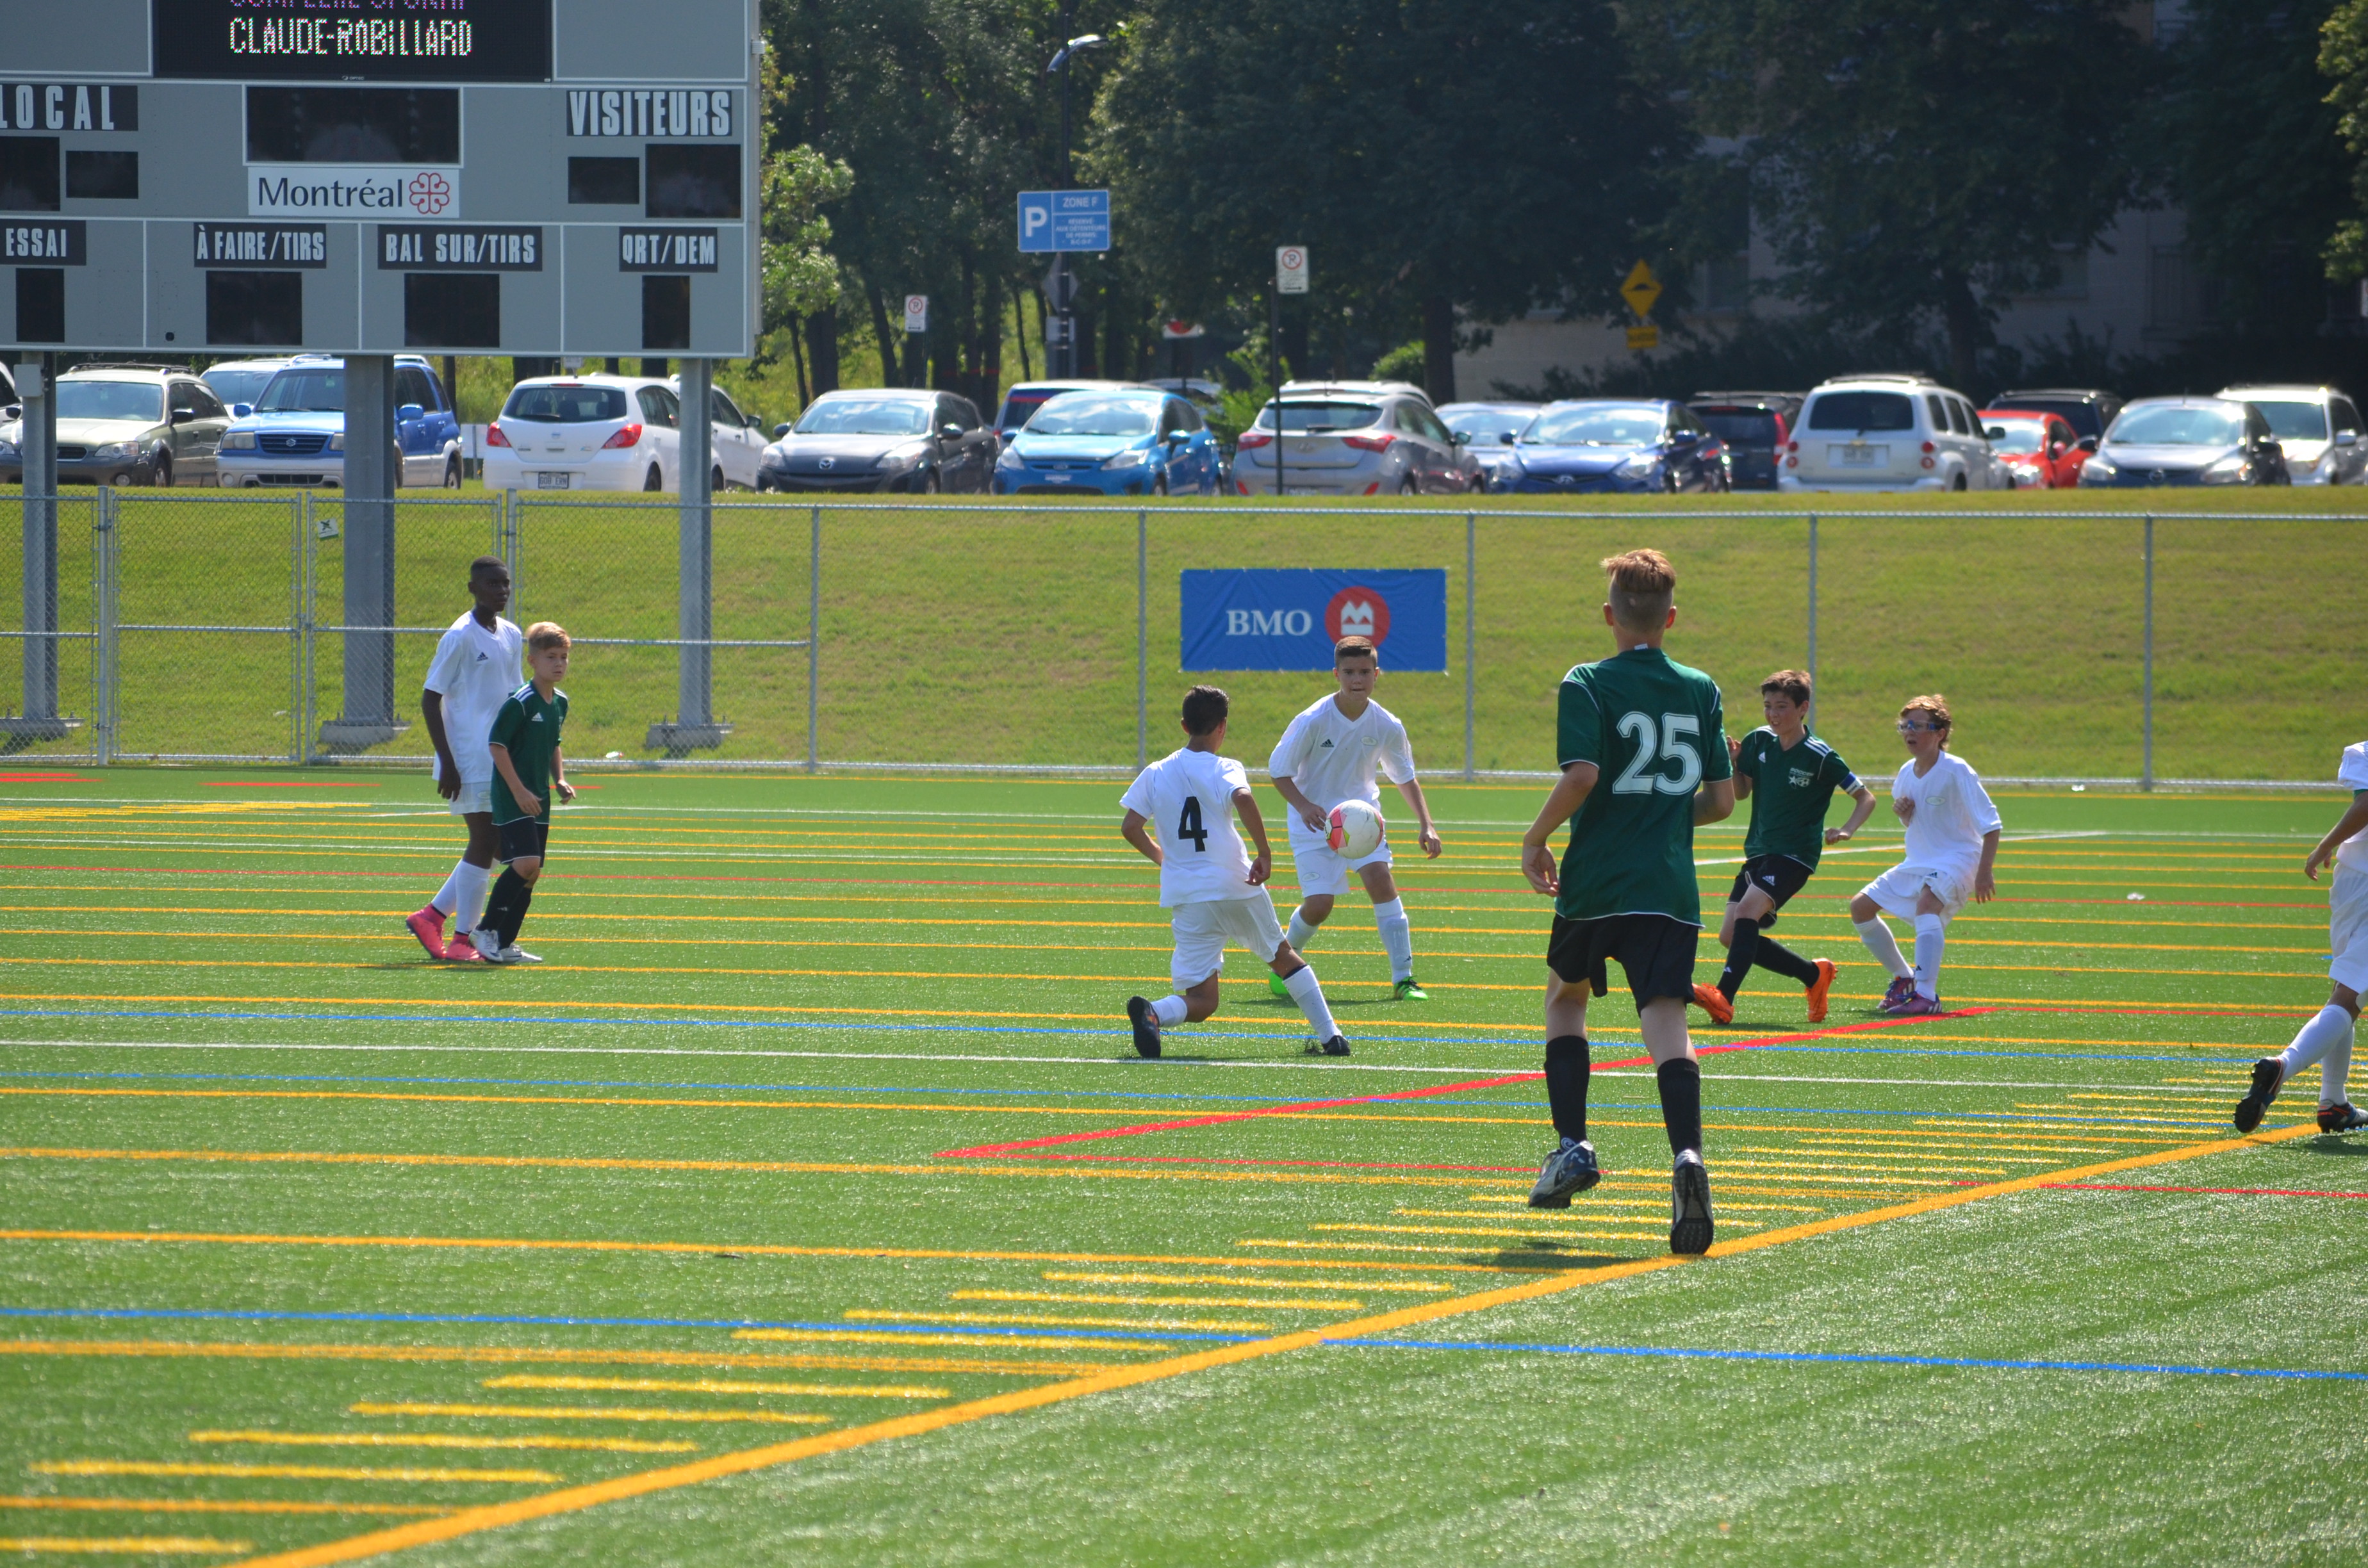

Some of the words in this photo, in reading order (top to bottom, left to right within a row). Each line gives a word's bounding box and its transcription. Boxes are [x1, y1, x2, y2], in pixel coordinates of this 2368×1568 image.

[229, 17, 472, 56] CLAUDE-ROBILLARD
[570, 91, 729, 136] VISITEURS
[258, 177, 404, 208] Montréal
[1062, 197, 1089, 208] ZONE
[1091, 197, 1098, 207] F
[5, 228, 67, 257] ESSAI
[197, 225, 208, 259] À
[386, 234, 423, 262] BAL
[435, 234, 535, 264] SUR/TIRS
[622, 235, 714, 265] QRT/DEM
[1226, 609, 1312, 636] BMO
[1612, 711, 1702, 795] 25
[1178, 796, 1208, 853] 4
